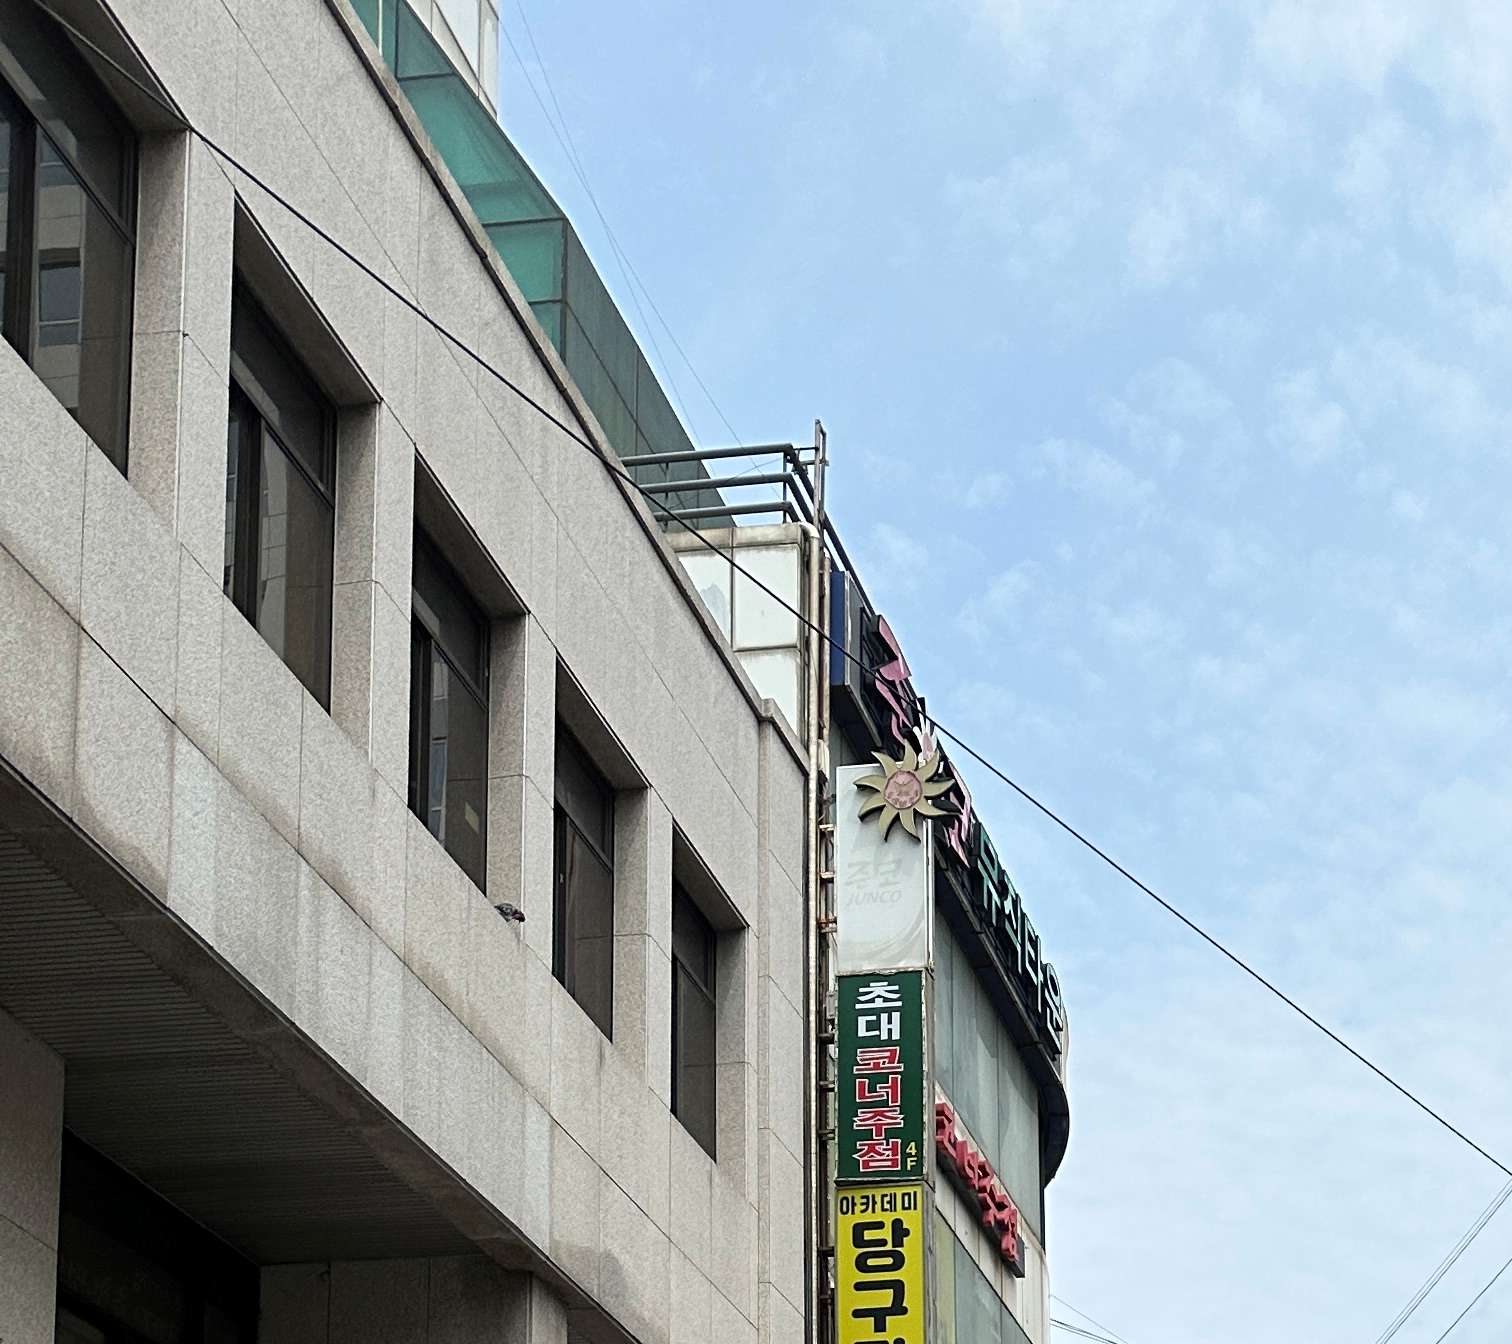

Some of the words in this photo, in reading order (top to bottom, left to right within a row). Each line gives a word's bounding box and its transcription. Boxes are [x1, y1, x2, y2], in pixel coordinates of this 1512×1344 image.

[853, 979, 903, 1042] 초대
[852, 1046, 904, 1173] 코너주점
[905, 1141, 918, 1172] 4F
[839, 1191, 918, 1216] 아카데미
